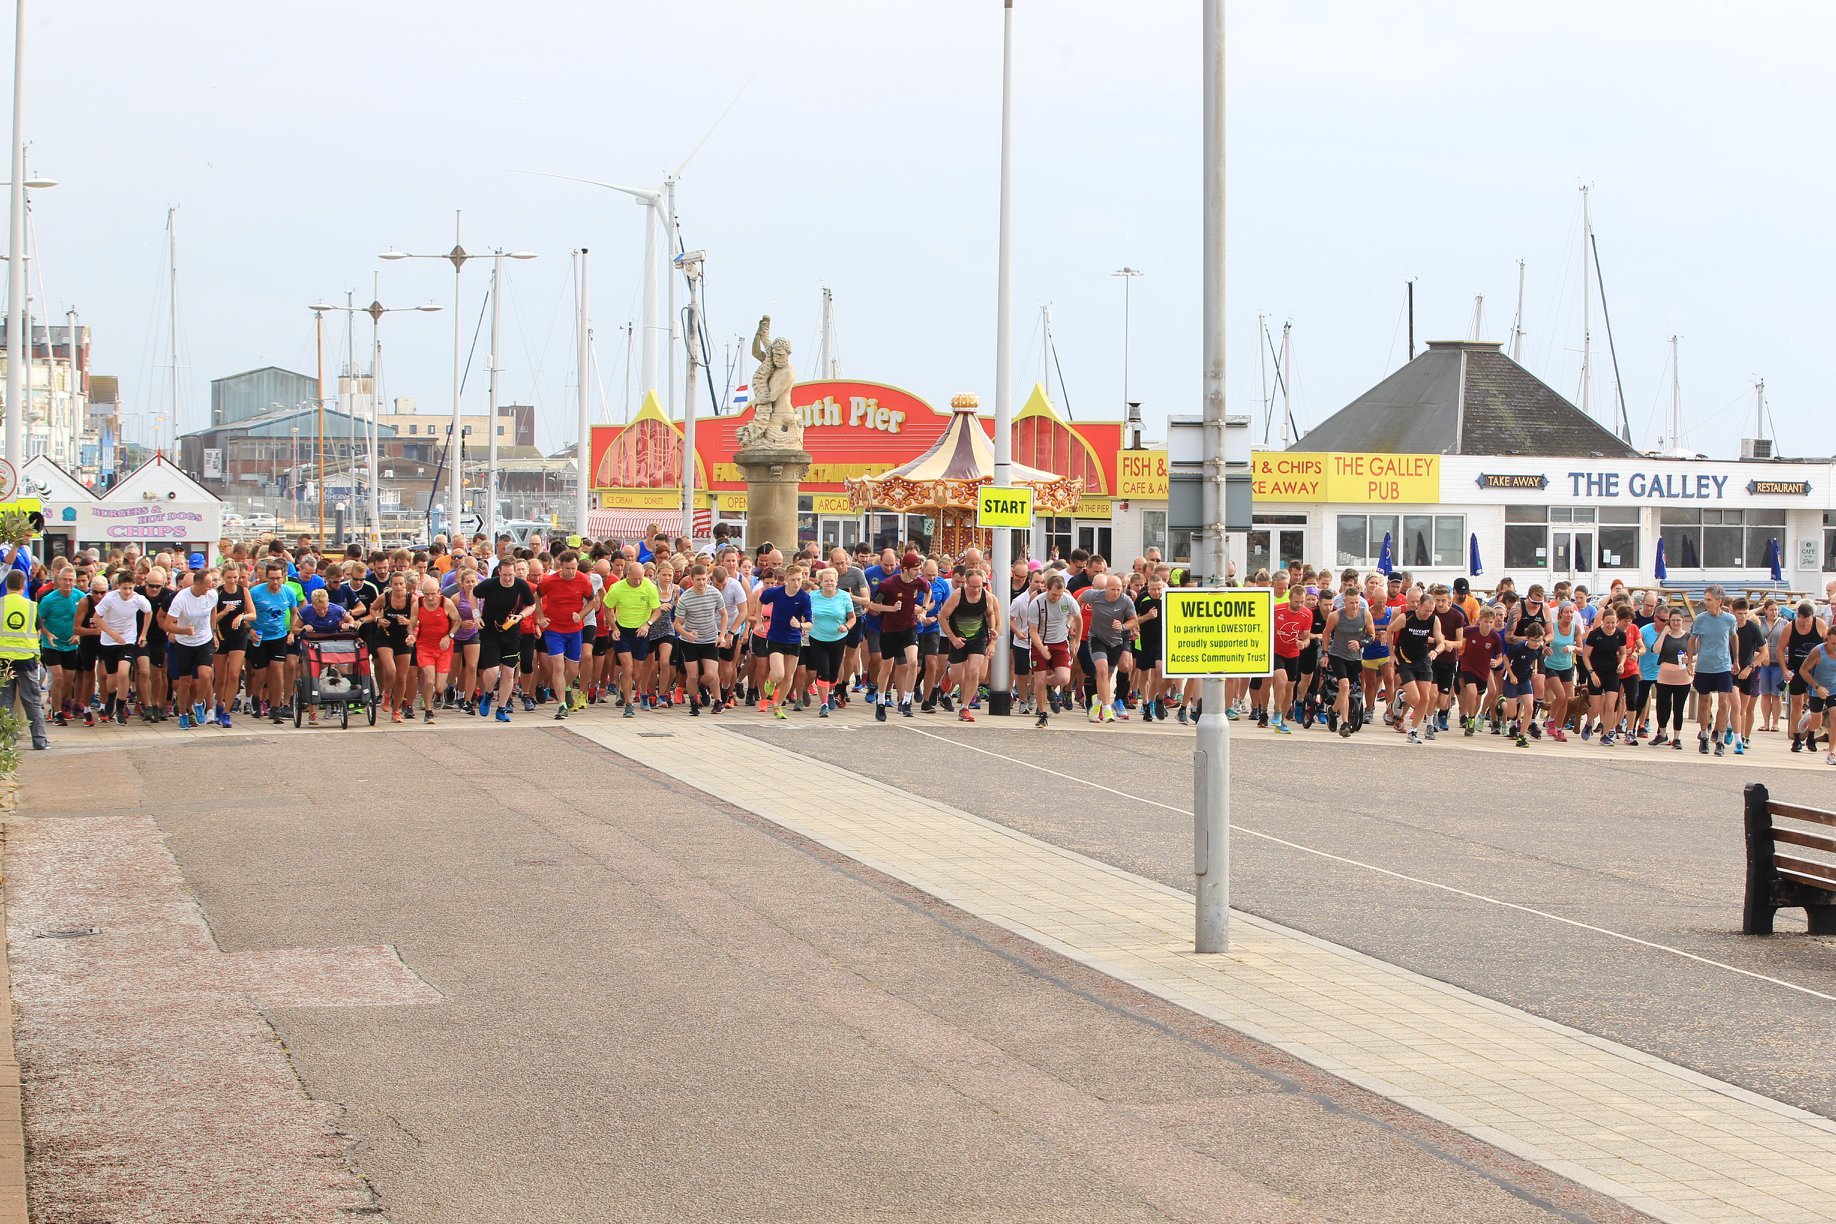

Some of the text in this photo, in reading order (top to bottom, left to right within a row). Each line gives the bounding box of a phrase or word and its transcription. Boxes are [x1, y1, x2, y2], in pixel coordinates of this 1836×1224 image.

[849, 396, 905, 433] Pier
[1123, 457, 1167, 477] FISH &
[1261, 461, 1273, 474] &
[1277, 461, 1322, 475] CHIPS
[1334, 457, 1434, 477] THE GALLEY
[1123, 482, 1146, 494] CAFE
[1148, 482, 1155, 494] &
[1251, 481, 1319, 495] KE AWAY
[1488, 476, 1540, 487] TAKE AWAY
[1568, 472, 1729, 499] THE GALLEY
[1757, 482, 1803, 493] RESTAURANT
[1368, 481, 1399, 500] PUB
[644, 497, 664, 505] DONUTS
[984, 499, 1027, 514] START
[92, 505, 161, 518] BURGERS &
[1085, 504, 1096, 513] THE
[1097, 504, 1110, 513] PIER
[138, 512, 203, 524] HOT DOGS
[107, 525, 187, 538] CHIPS
[1181, 601, 1256, 618] WELCOME
[1174, 625, 1181, 633] to
[1184, 624, 1214, 634] parkrun
[1178, 638, 1259, 648] proudly supported by
[1171, 653, 1266, 663] Access Community Trust
